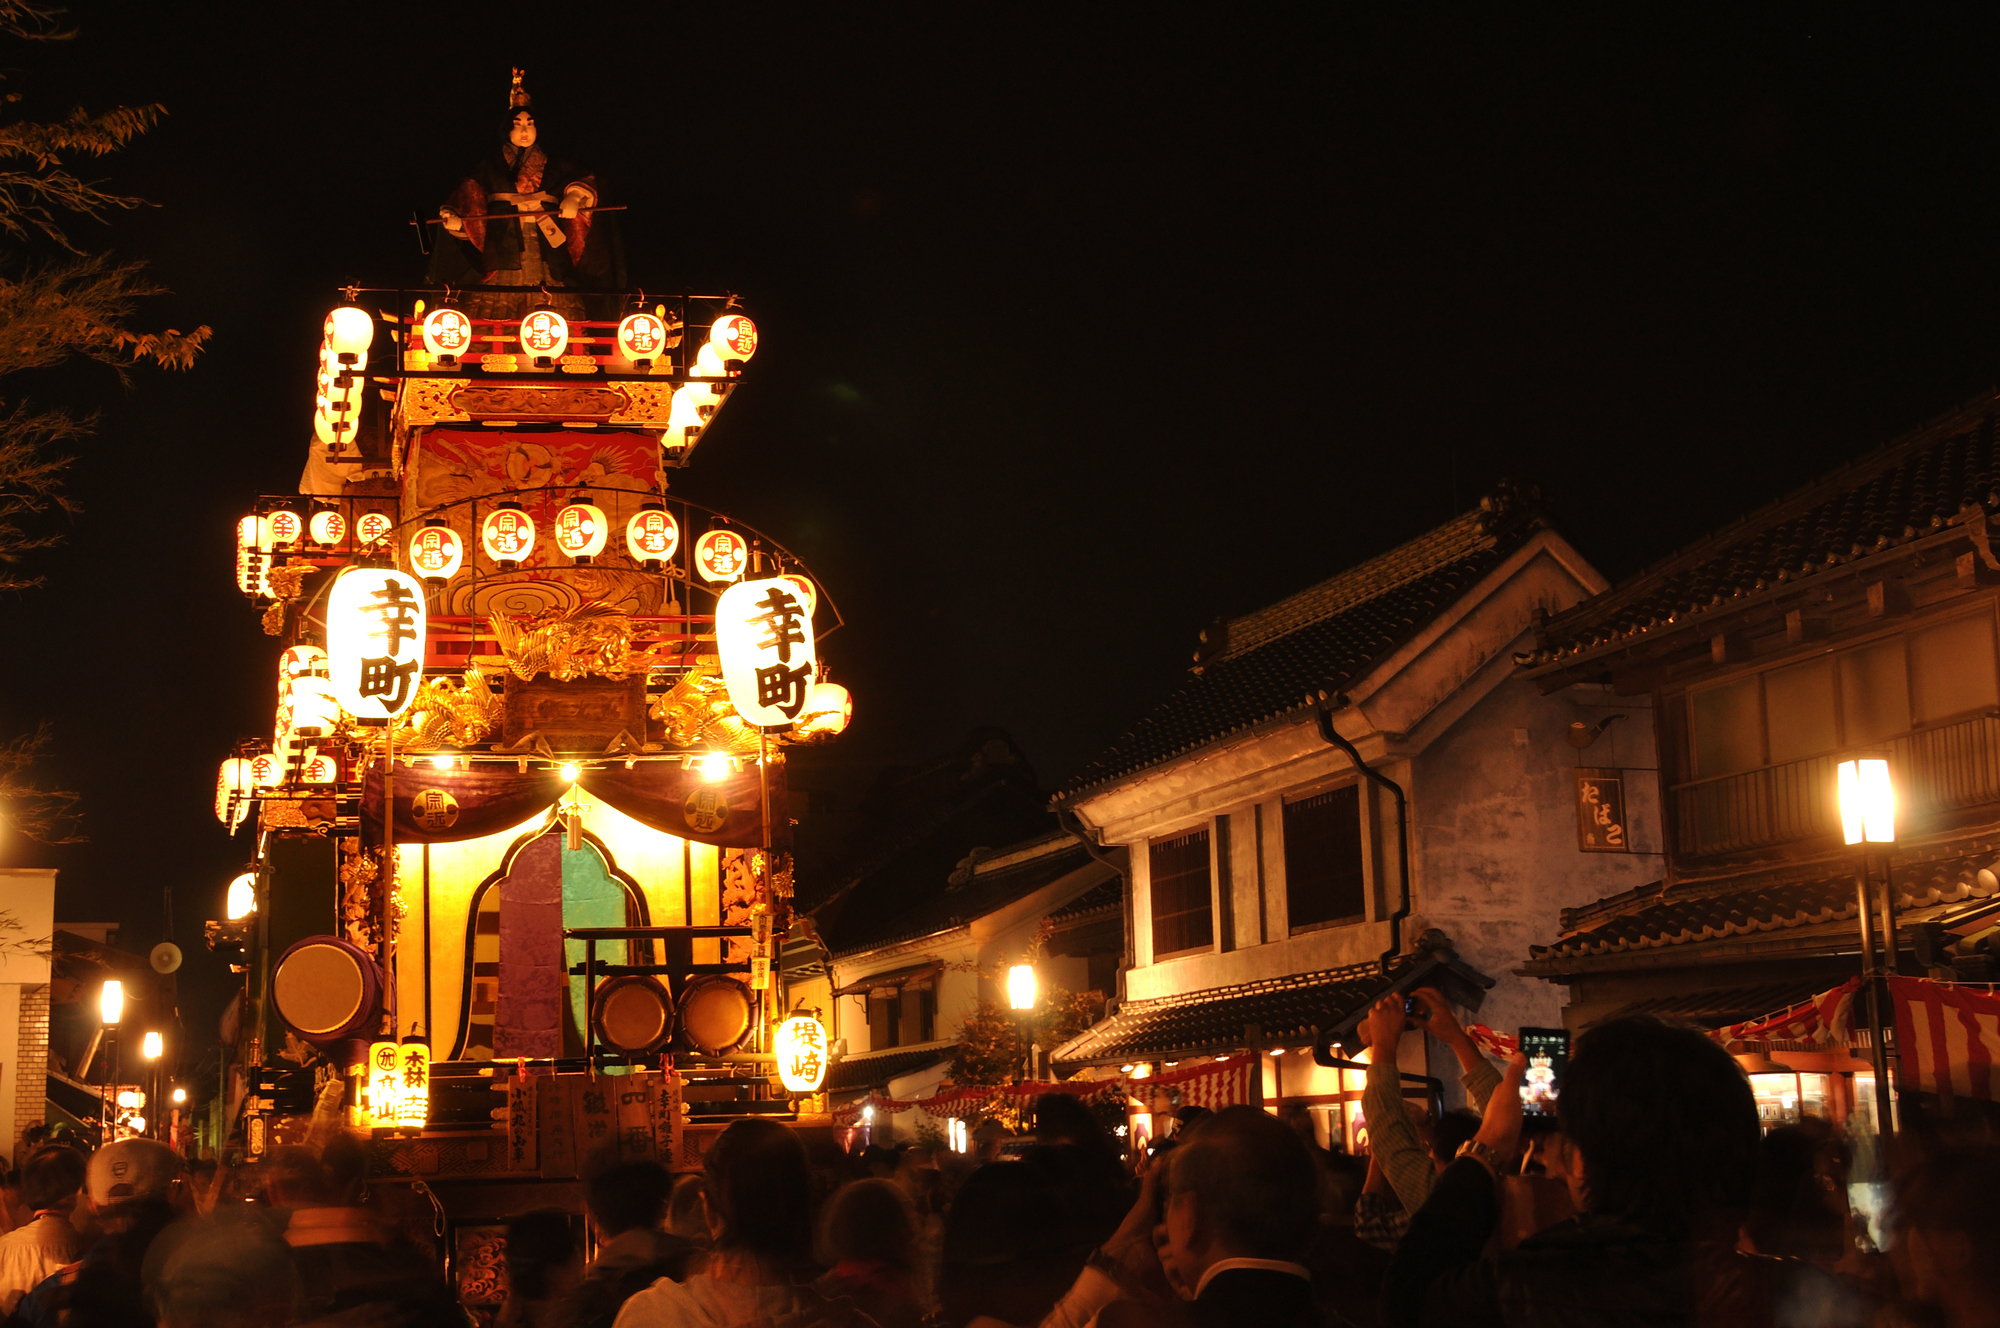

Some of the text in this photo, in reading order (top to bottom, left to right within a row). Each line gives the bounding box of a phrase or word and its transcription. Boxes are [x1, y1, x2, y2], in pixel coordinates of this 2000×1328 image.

[358, 578, 420, 714] 幸町
[744, 587, 813, 720] 幸町
[1581, 781, 1622, 845] たばこ
[790, 1021, 823, 1084] 堤崎
[620, 1091, 653, 1154] 四番
